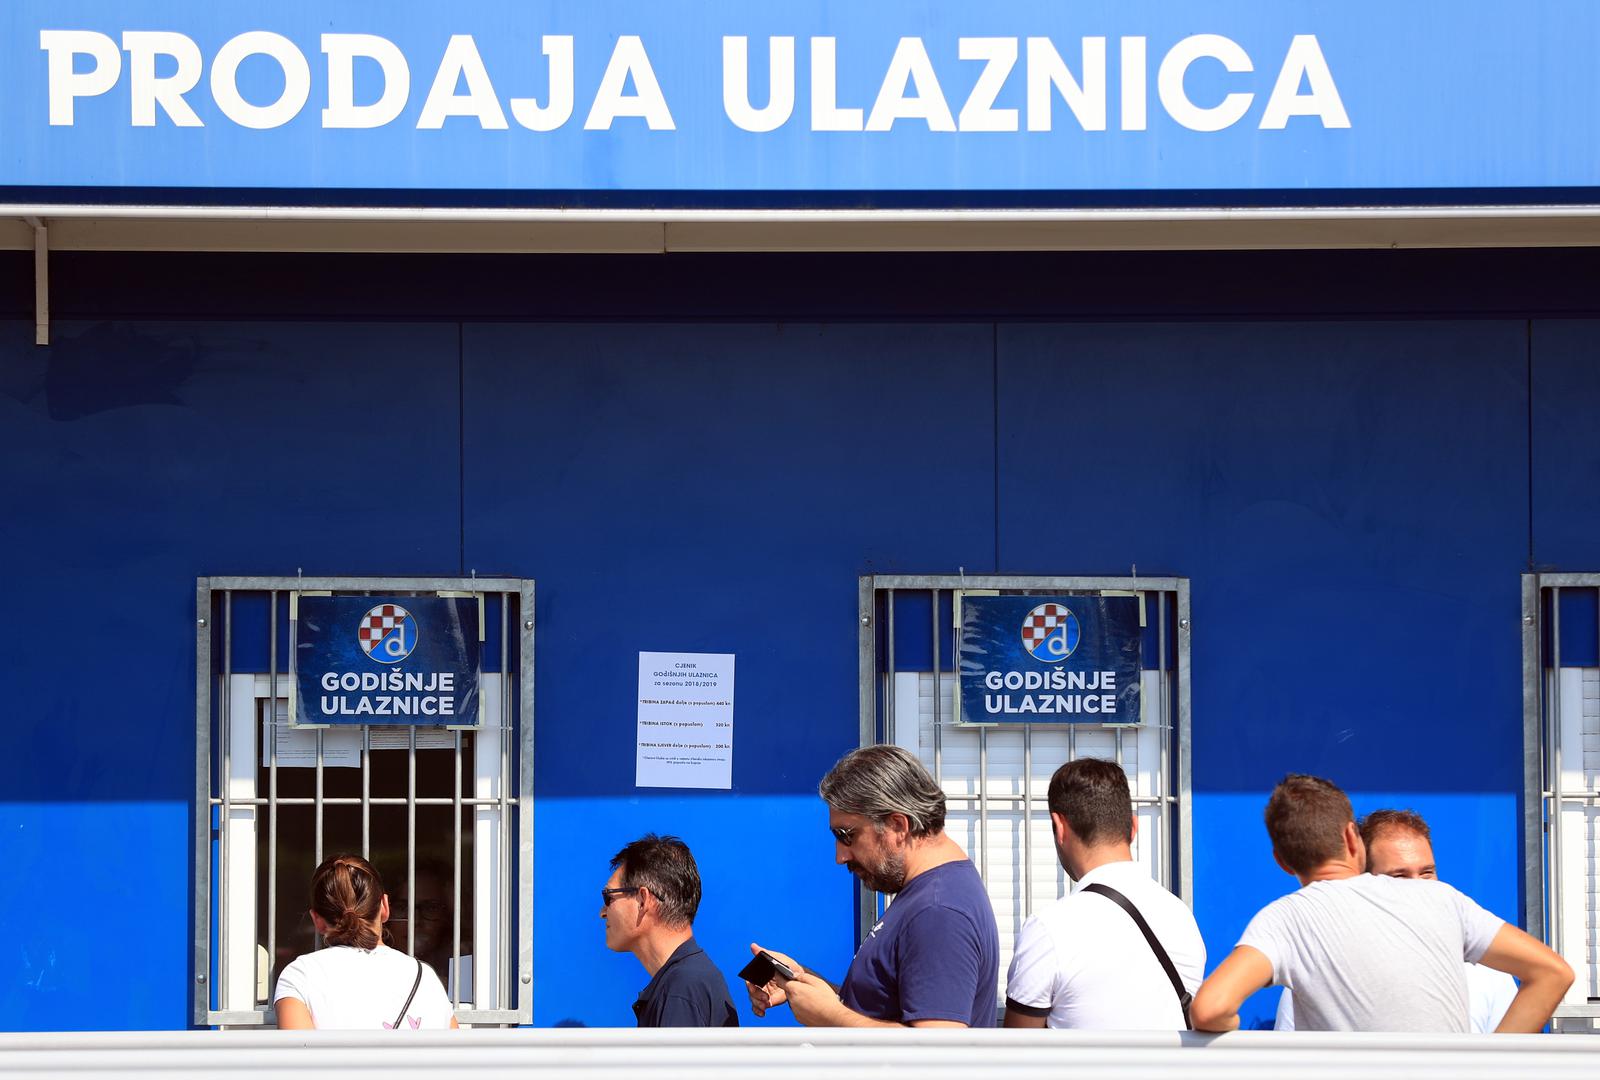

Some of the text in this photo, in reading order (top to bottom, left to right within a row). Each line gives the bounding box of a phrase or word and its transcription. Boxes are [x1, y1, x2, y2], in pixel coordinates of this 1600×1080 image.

[40, 30, 1351, 132] PRODAJA ULAZNICA
[321, 667, 455, 692] GODIŠNJE
[985, 666, 1116, 690] GODIŠNJE
[321, 696, 455, 715] ULAZNICE
[985, 694, 1117, 714] ULAZNICE
